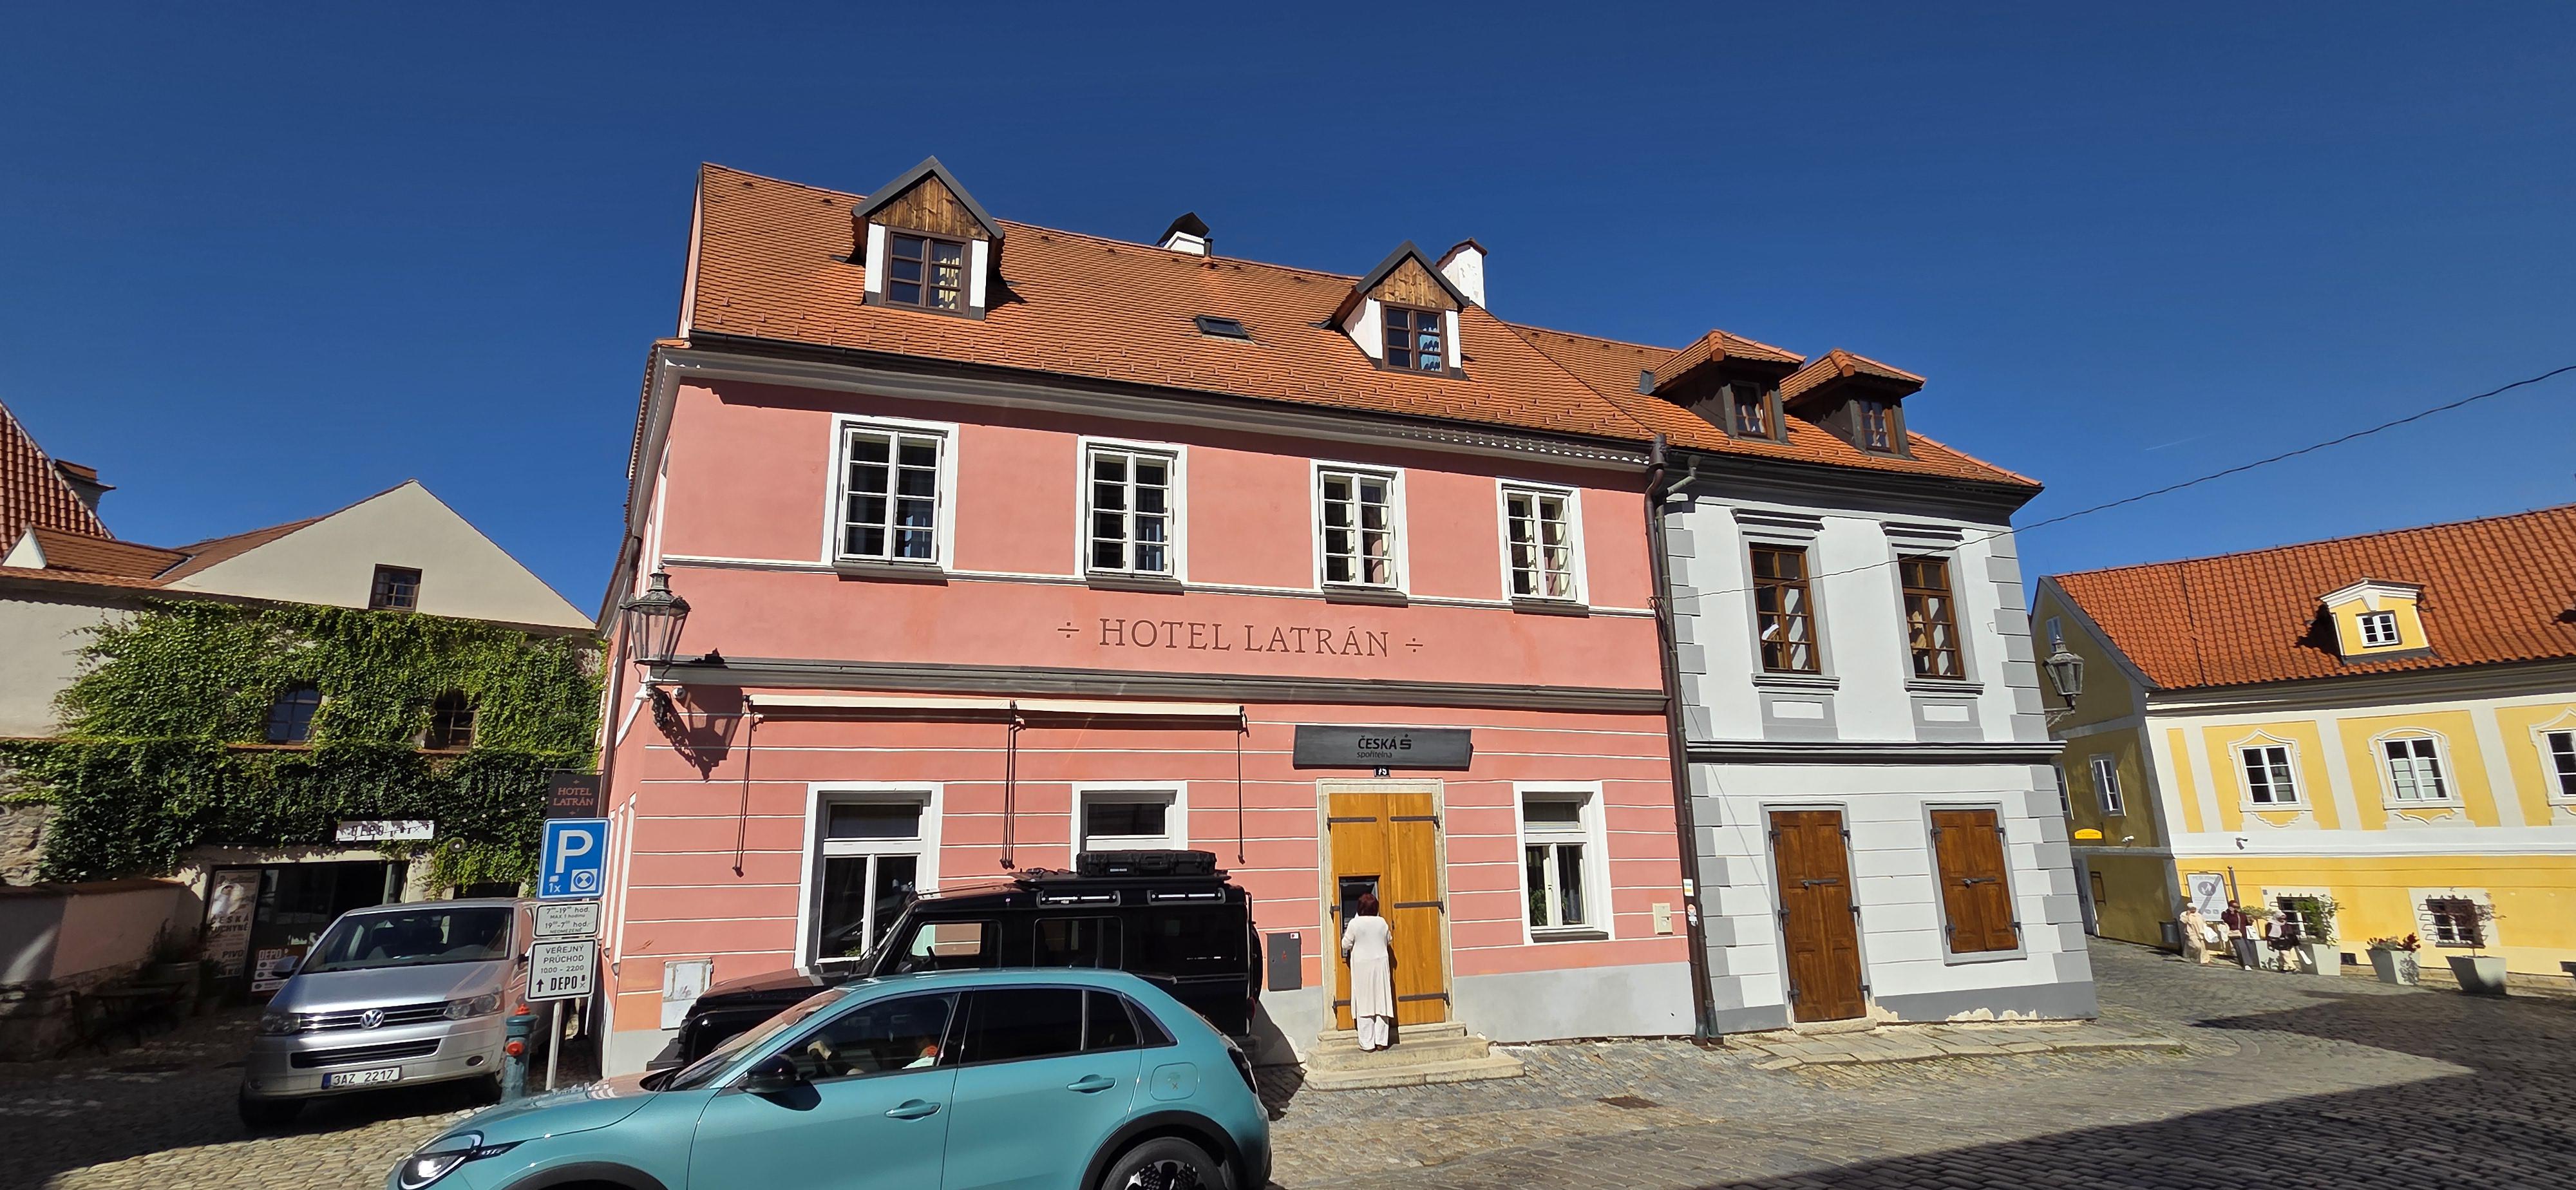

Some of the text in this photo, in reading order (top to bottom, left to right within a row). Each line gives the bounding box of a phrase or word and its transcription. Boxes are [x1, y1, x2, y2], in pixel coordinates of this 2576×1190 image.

[1099, 618, 1389, 657] HOTEL LATRÁN
[1358, 735, 1397, 750] ČESKÁ
[1356, 750, 1392, 759] spořitelna
[558, 787, 592, 795] HOTEL
[553, 797, 594, 806] LATRÁN
[555, 829, 593, 873] P
[549, 883, 561, 893] 1x
[222, 949, 244, 958] PIVO
[258, 949, 282, 959] DEPO
[545, 944, 584, 954] VEŘEJNÝ
[550, 976, 578, 991] DEPO
[334, 1070, 393, 1085] 3AZ 2217
